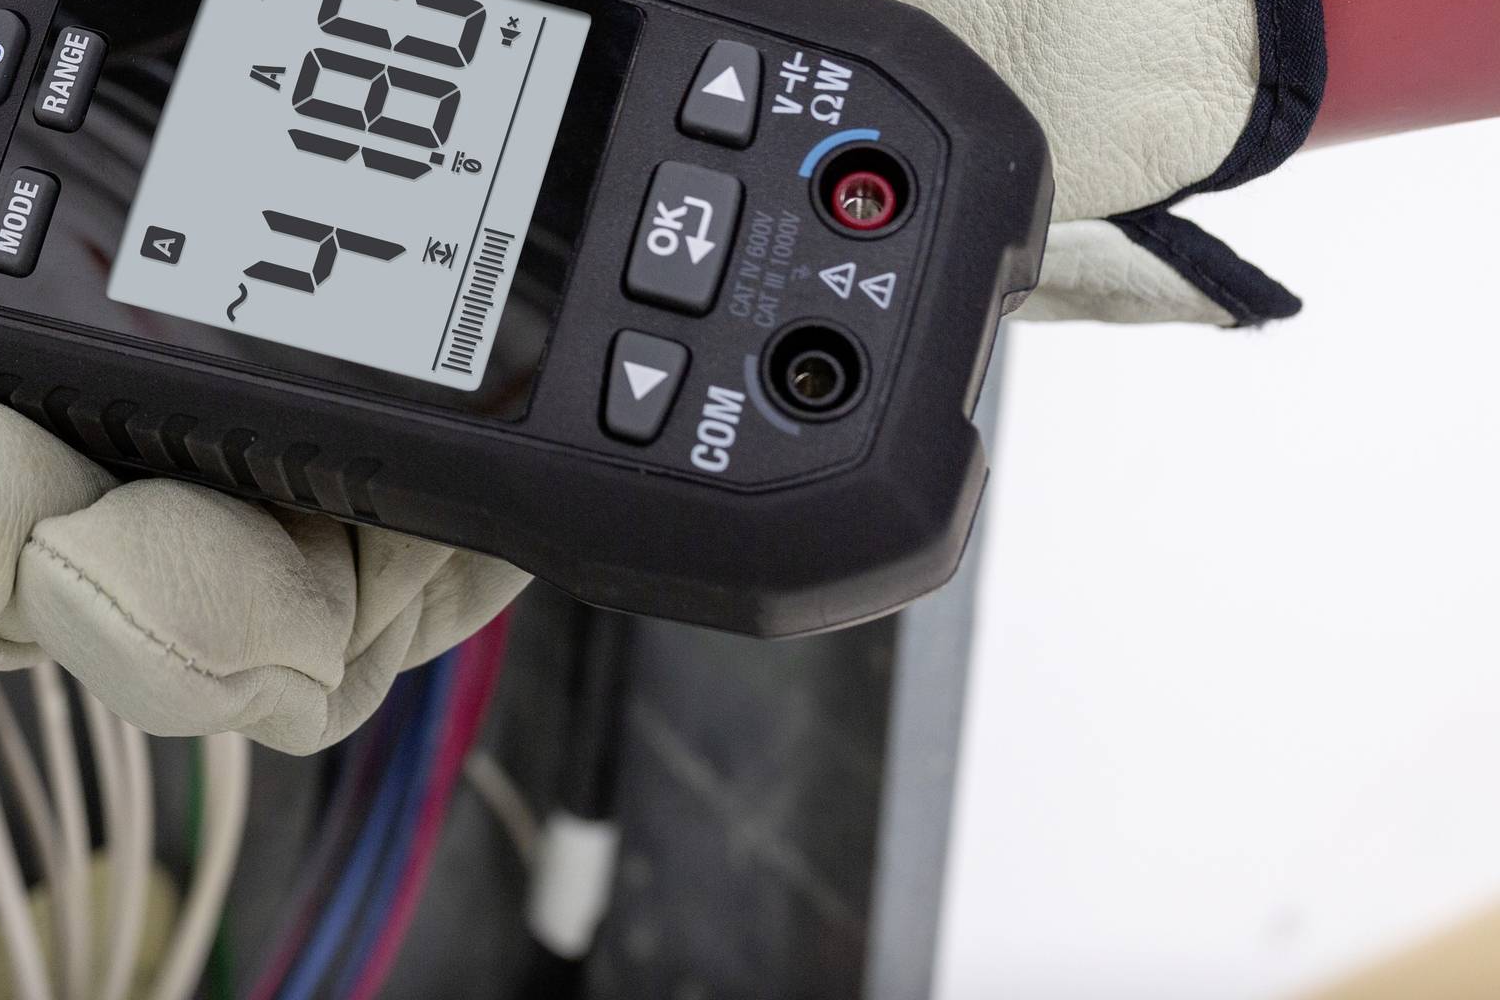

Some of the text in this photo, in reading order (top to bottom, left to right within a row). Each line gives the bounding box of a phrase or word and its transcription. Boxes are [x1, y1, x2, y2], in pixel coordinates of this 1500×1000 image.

[42, 31, 90, 115] RANGE
[250, 64, 287, 91] A
[646, 201, 689, 257] OK
[728, 210, 774, 318] CAT IV 600V
[753, 209, 800, 328] CAT III 1000V
[690, 385, 746, 473] COM
